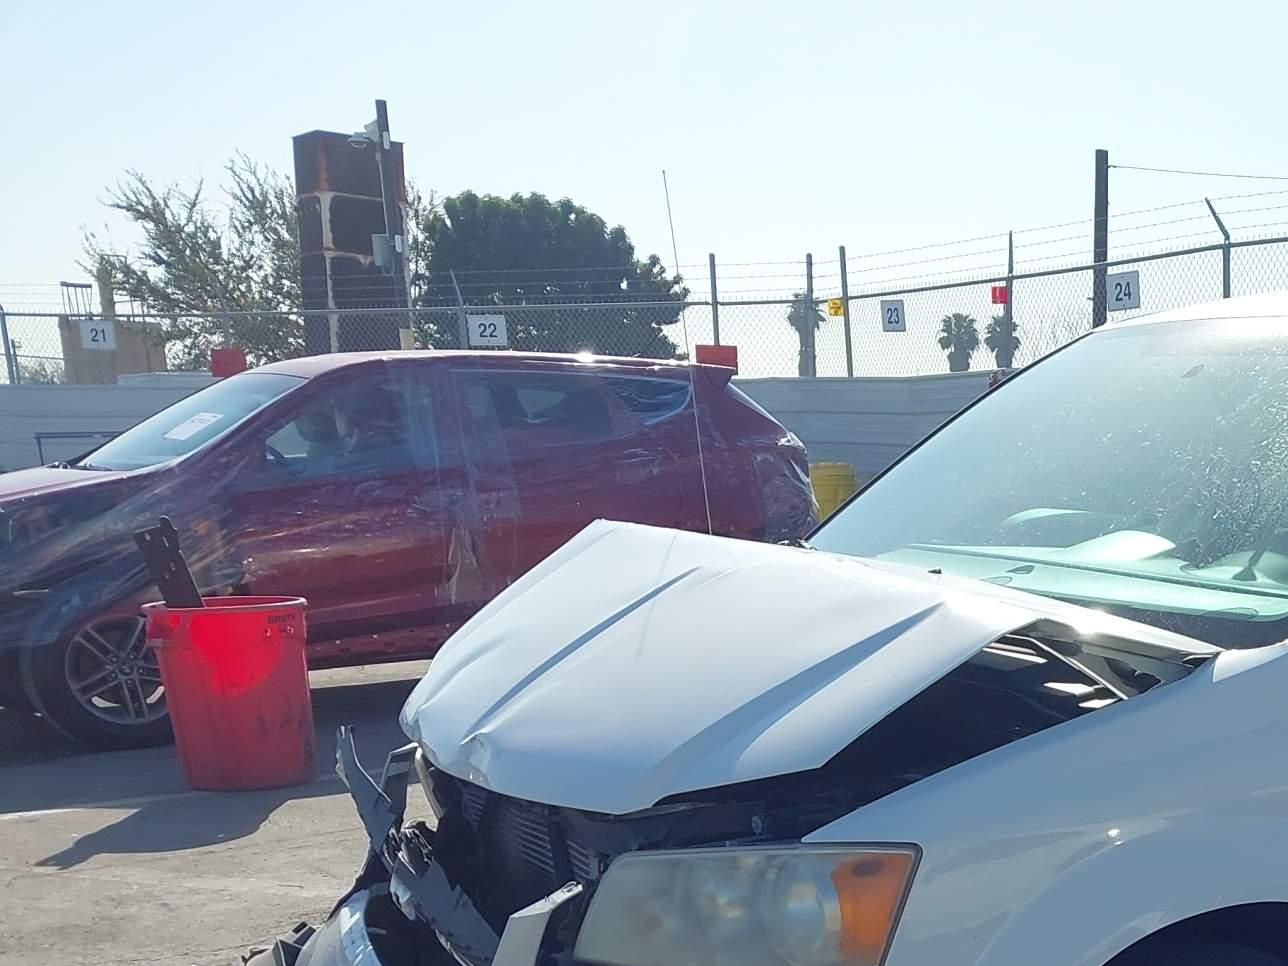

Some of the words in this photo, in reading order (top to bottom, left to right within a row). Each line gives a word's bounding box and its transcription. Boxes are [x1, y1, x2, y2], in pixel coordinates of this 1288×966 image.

[1114, 281, 1132, 302] 24
[886, 307, 900, 325] 23
[90, 327, 106, 343] 21
[478, 322, 498, 338] 22
